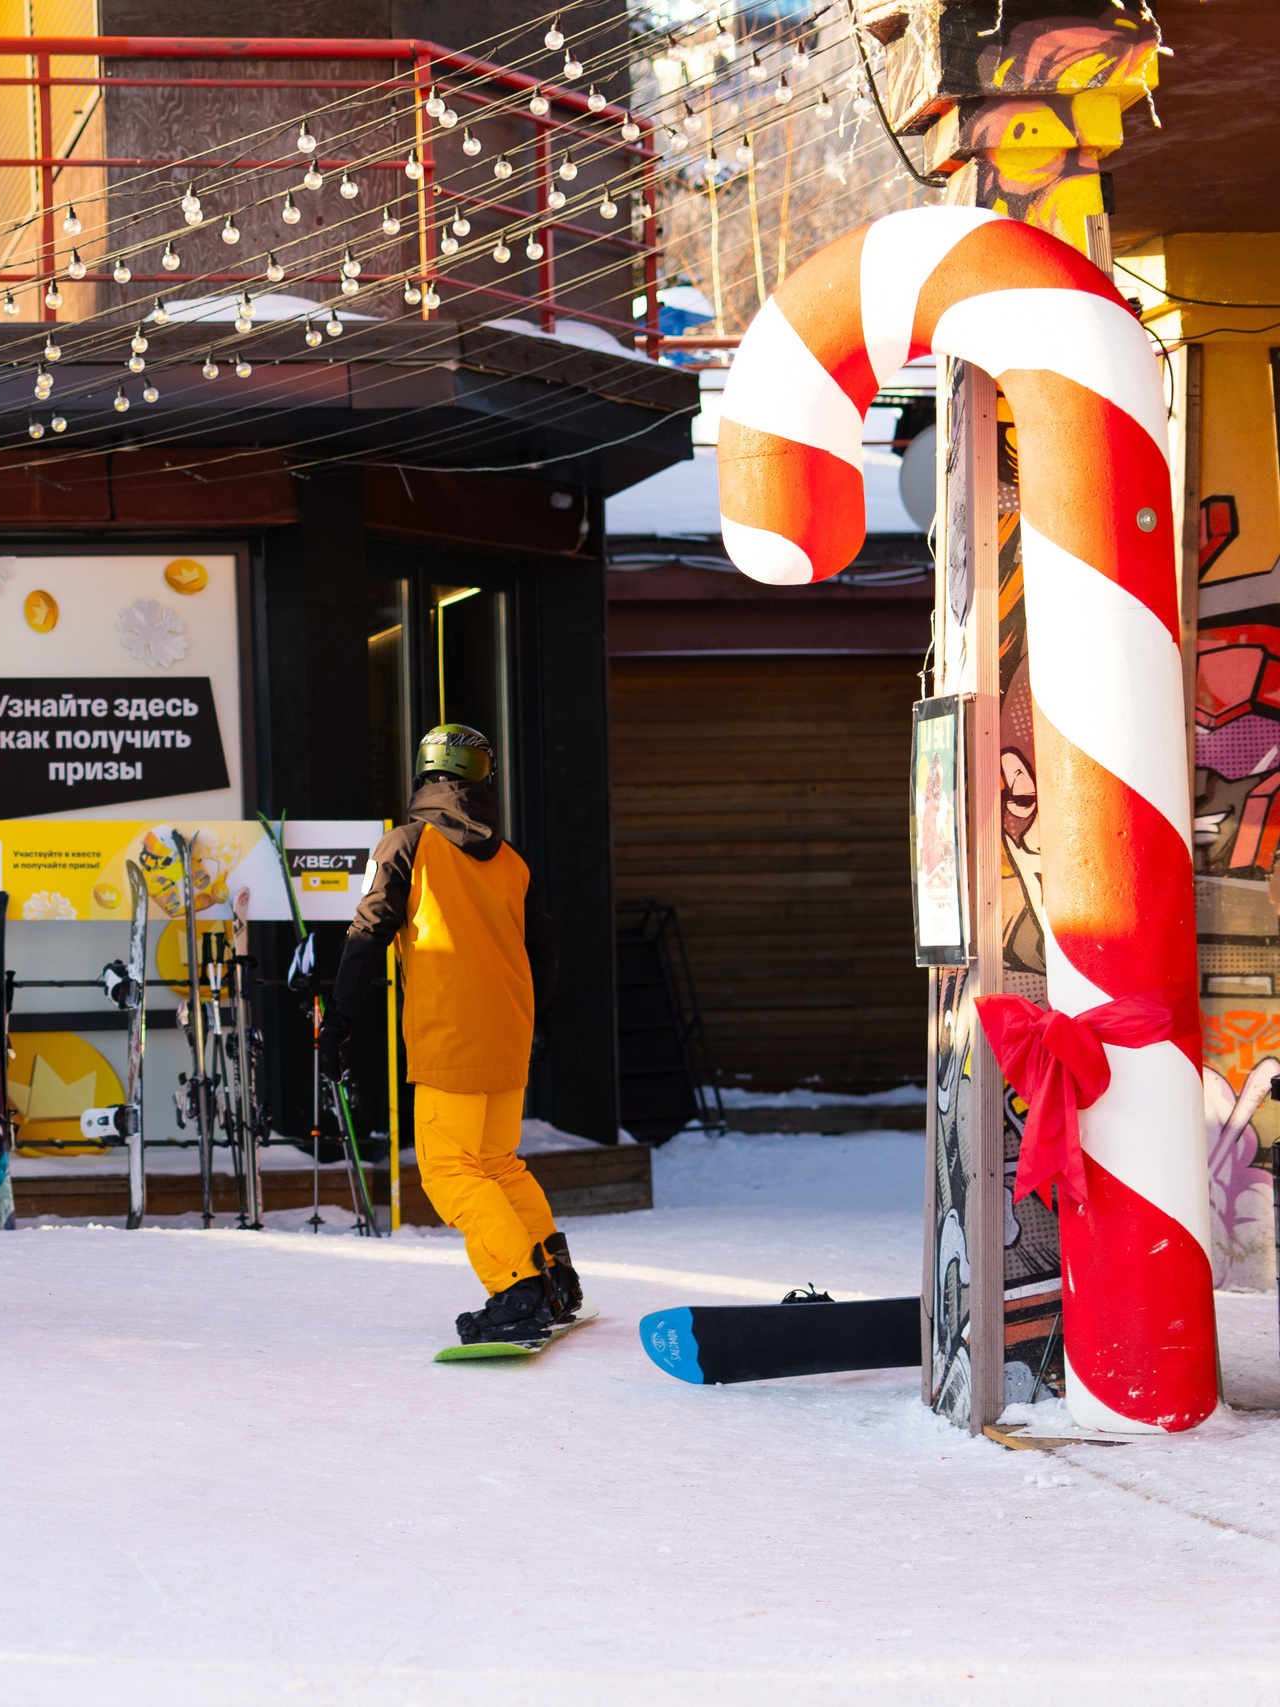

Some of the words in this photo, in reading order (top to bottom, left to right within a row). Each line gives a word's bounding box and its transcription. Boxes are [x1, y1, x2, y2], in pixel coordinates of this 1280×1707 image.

[113, 698, 199, 721] здесь
[0, 730, 50, 749] как
[55, 729, 192, 754] получить
[48, 761, 143, 786] призы
[13, 850, 63, 859] Участвуйте
[292, 855, 357, 868] КВЕСТ
[21, 861, 67, 870] получайте
[68, 861, 100, 870] призы!
